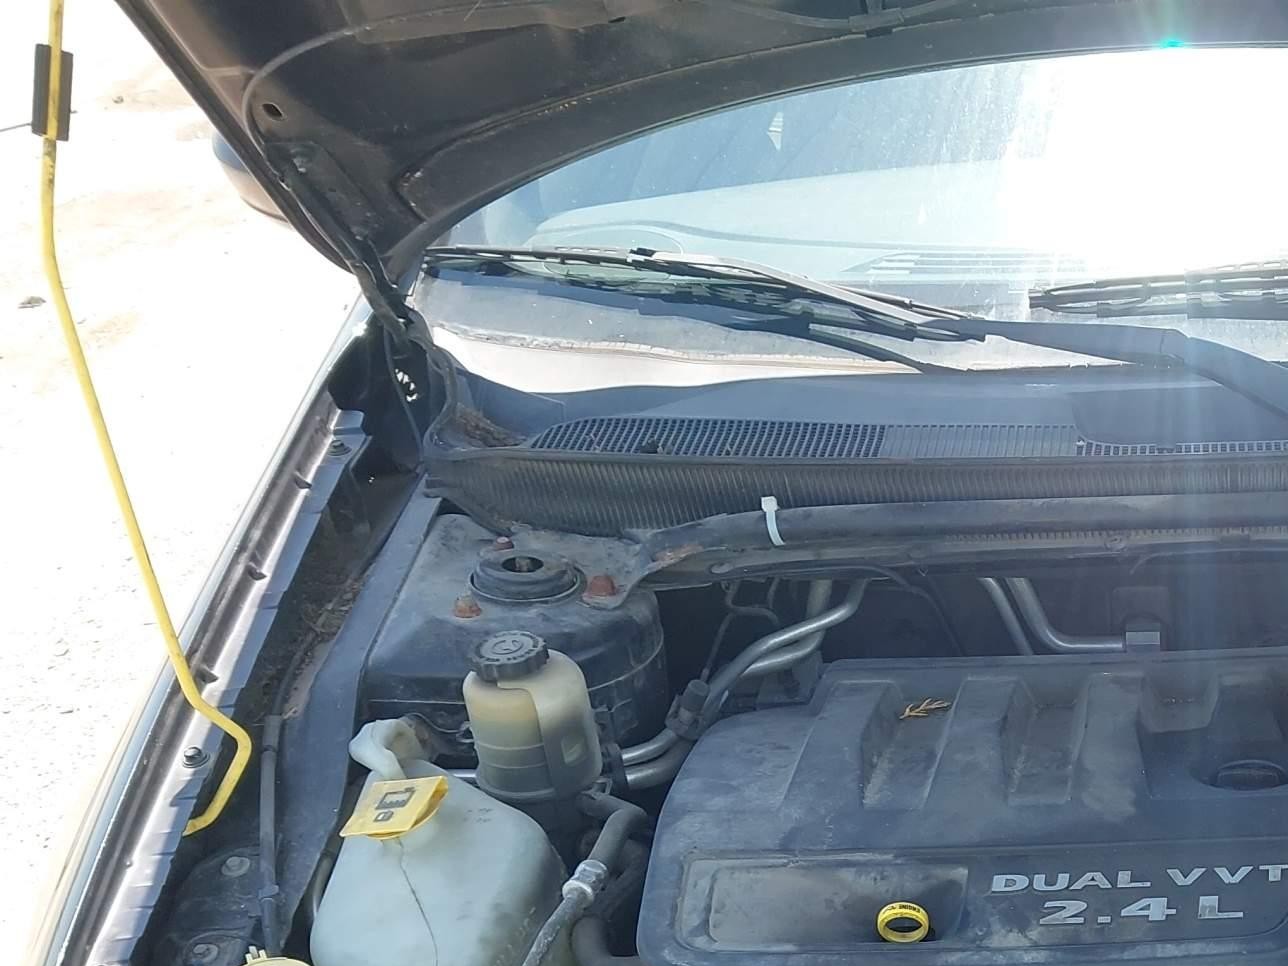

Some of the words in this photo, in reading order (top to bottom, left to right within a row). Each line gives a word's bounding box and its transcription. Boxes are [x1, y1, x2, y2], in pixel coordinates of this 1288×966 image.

[991, 870, 1151, 892] DUAL
[1039, 897, 1177, 925] 2.4
[1197, 895, 1244, 919] L
